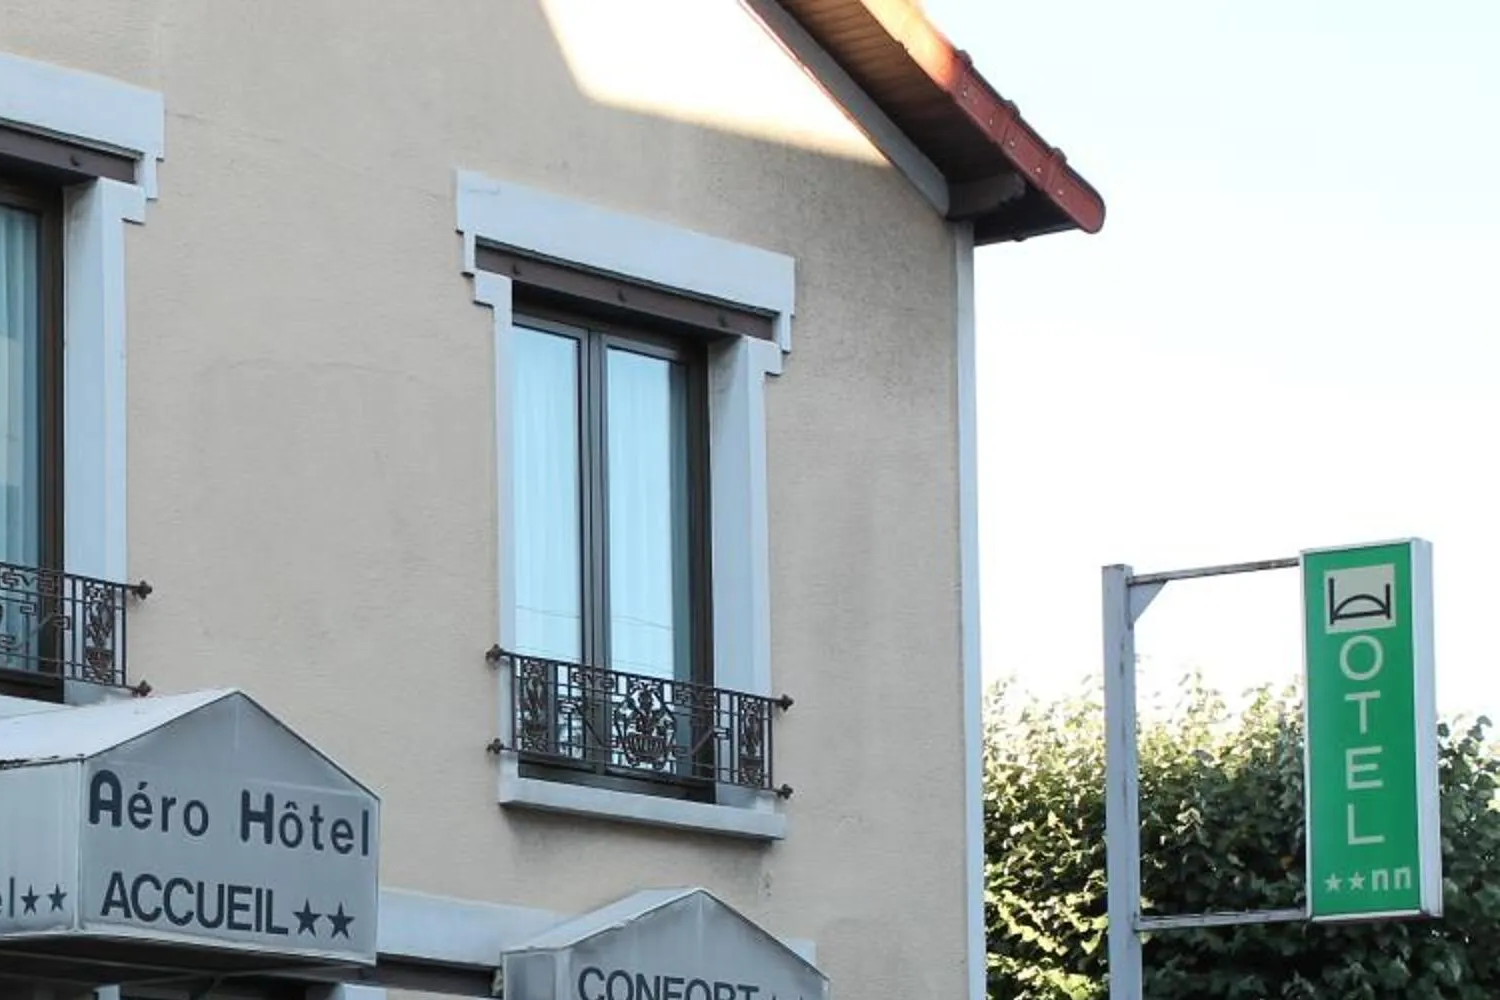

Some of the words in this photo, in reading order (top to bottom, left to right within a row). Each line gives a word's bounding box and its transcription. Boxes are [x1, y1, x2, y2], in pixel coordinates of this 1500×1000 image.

[88, 769, 210, 838] Aéro
[240, 790, 370, 856] Hôtel
[101, 871, 289, 935] ACCUEIL
